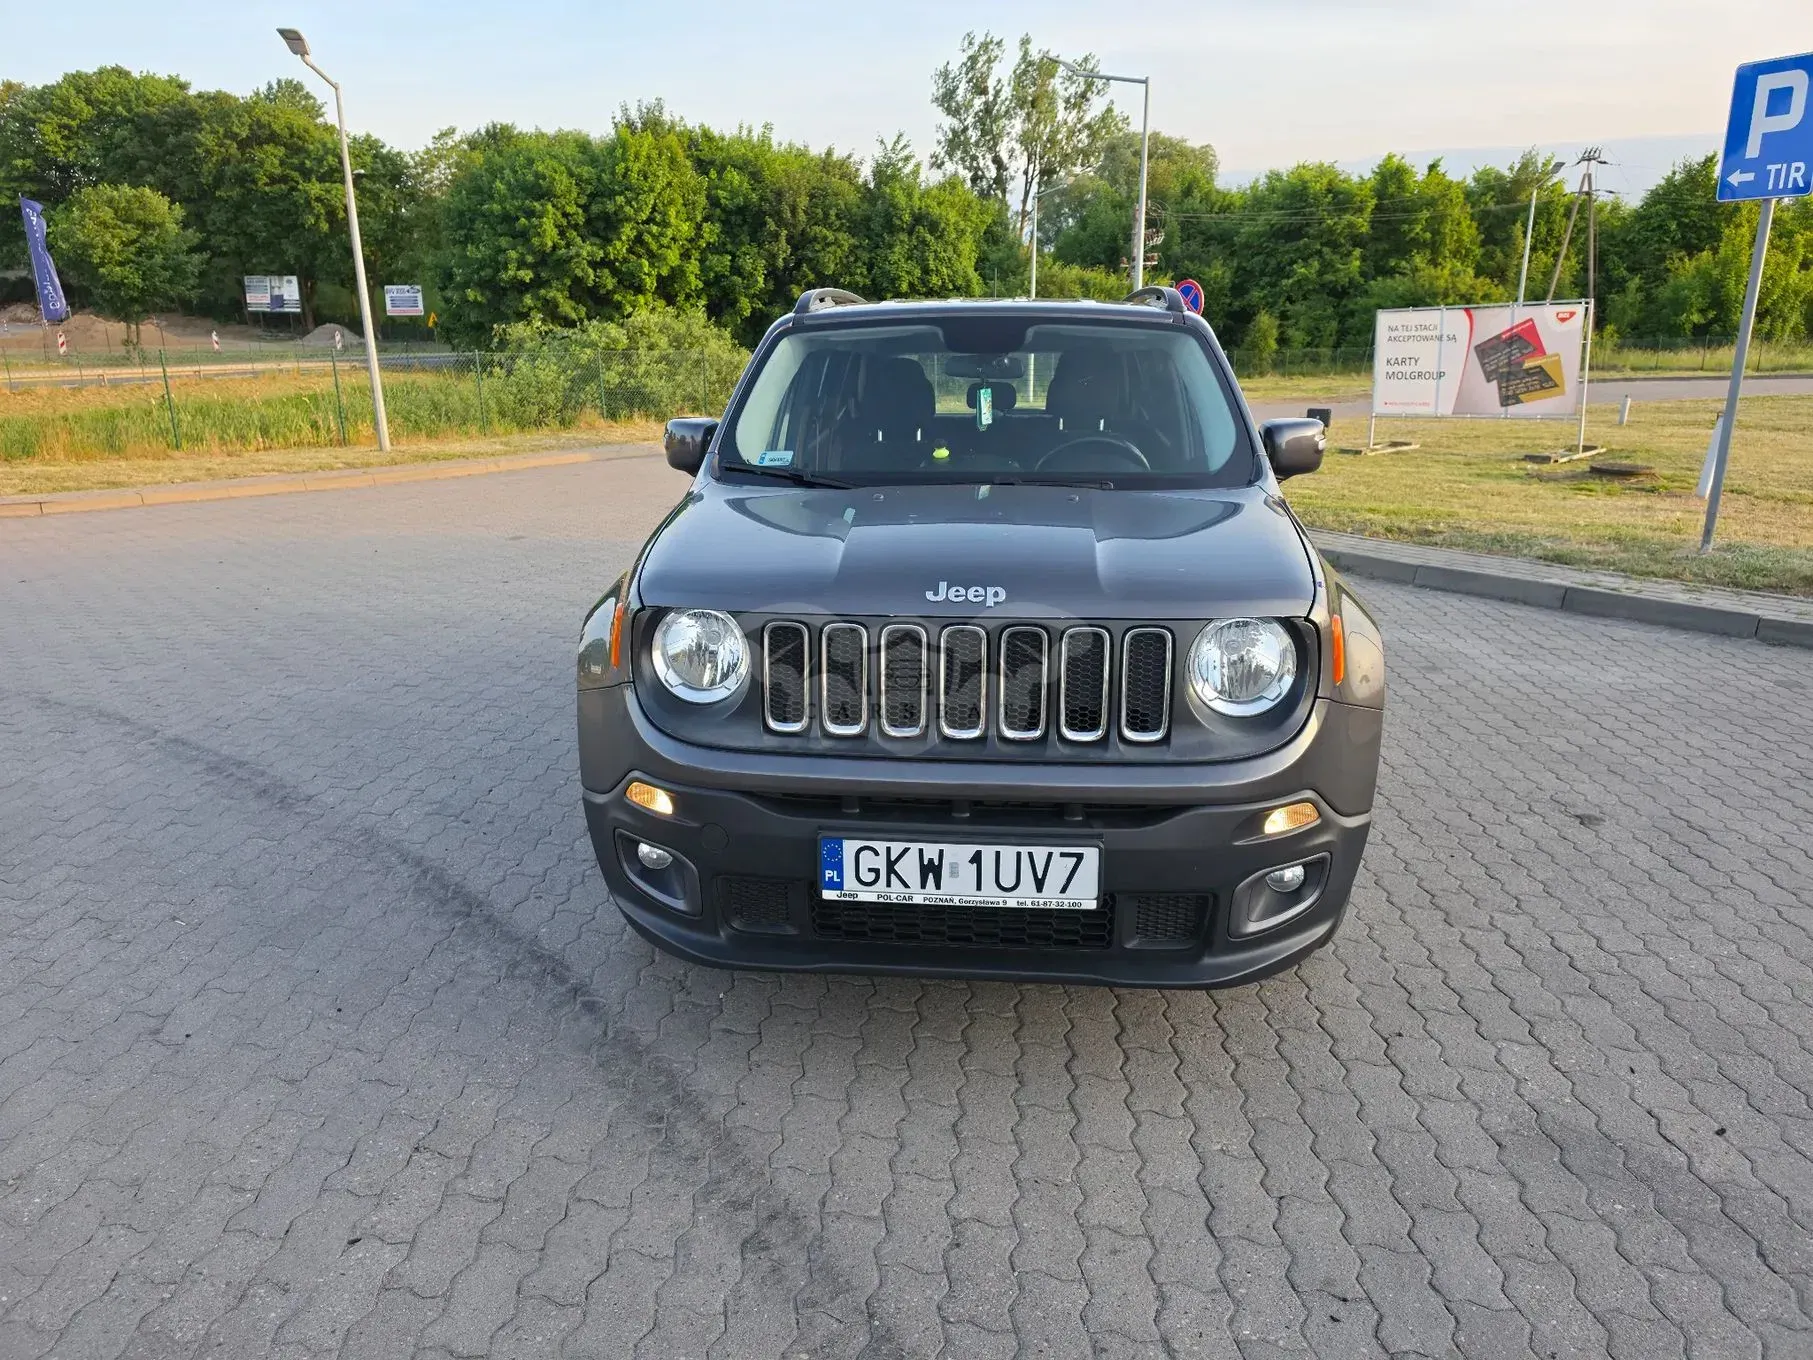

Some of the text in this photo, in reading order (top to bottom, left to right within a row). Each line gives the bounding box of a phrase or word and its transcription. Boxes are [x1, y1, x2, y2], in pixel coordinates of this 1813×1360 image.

[1745, 69, 1809, 159] P
[1766, 162, 1806, 190] TIR
[1401, 324, 1413, 332] TEJ
[1414, 323, 1438, 332] STACJI
[1387, 333, 1457, 343] AKCEPTOWANE SĄ
[1386, 357, 1420, 367] KARTY
[1385, 371, 1446, 381] MOLGROUP
[925, 581, 1006, 607] Jeep
[825, 870, 840, 882] PL
[854, 845, 1085, 894] GKW 1UV7
[836, 891, 859, 900] Jeep
[876, 893, 914, 903] POL-CAR
[958, 898, 1000, 907] Gorzysława
[1016, 899, 1029, 908] tel.
[1030, 900, 1082, 909] 61-87-32-100
